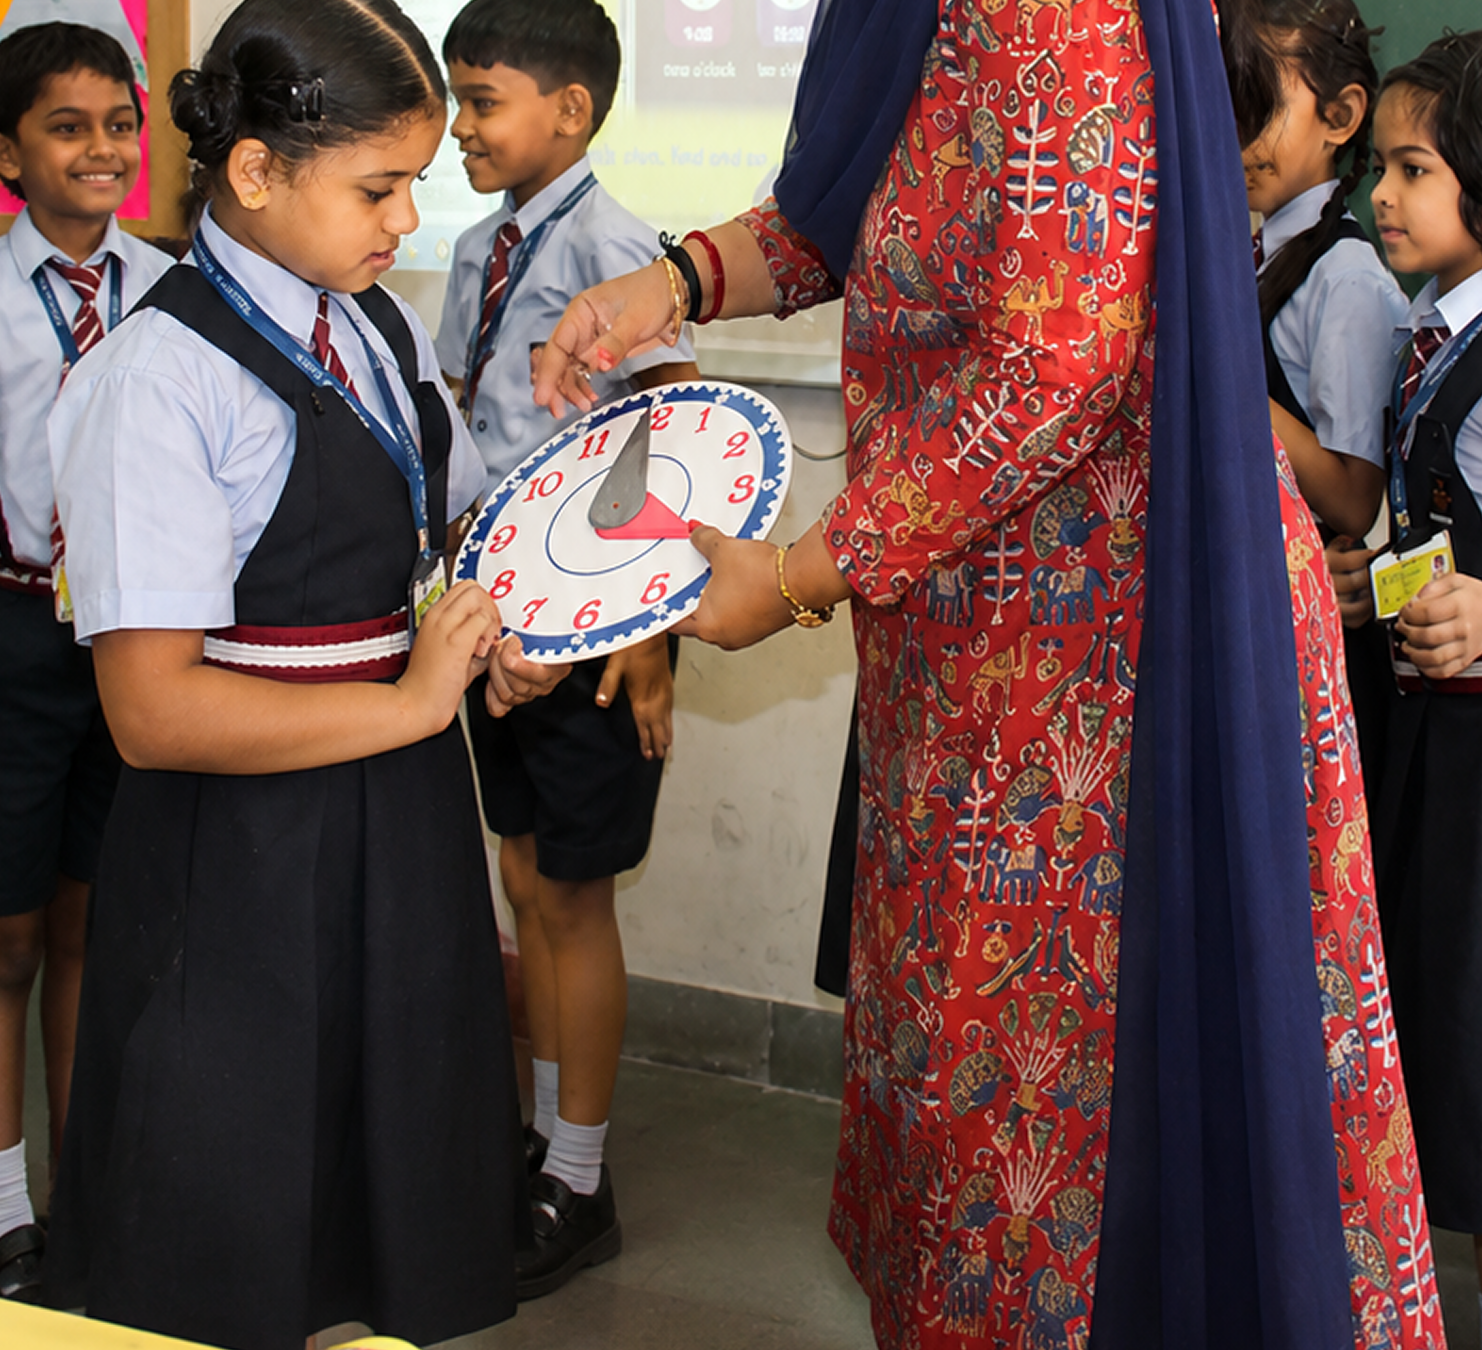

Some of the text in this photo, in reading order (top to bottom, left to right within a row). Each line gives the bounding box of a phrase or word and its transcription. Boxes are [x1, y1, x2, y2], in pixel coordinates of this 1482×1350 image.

[649, 405, 675, 432] 2
[695, 406, 711, 434] 1
[577, 429, 610, 461] 11
[722, 430, 751, 460] 2
[522, 470, 564, 503] 10
[728, 474, 755, 504] 3
[488, 524, 518, 554] 9
[489, 570, 516, 600] 8
[522, 597, 549, 630] 7
[573, 599, 602, 631] 6
